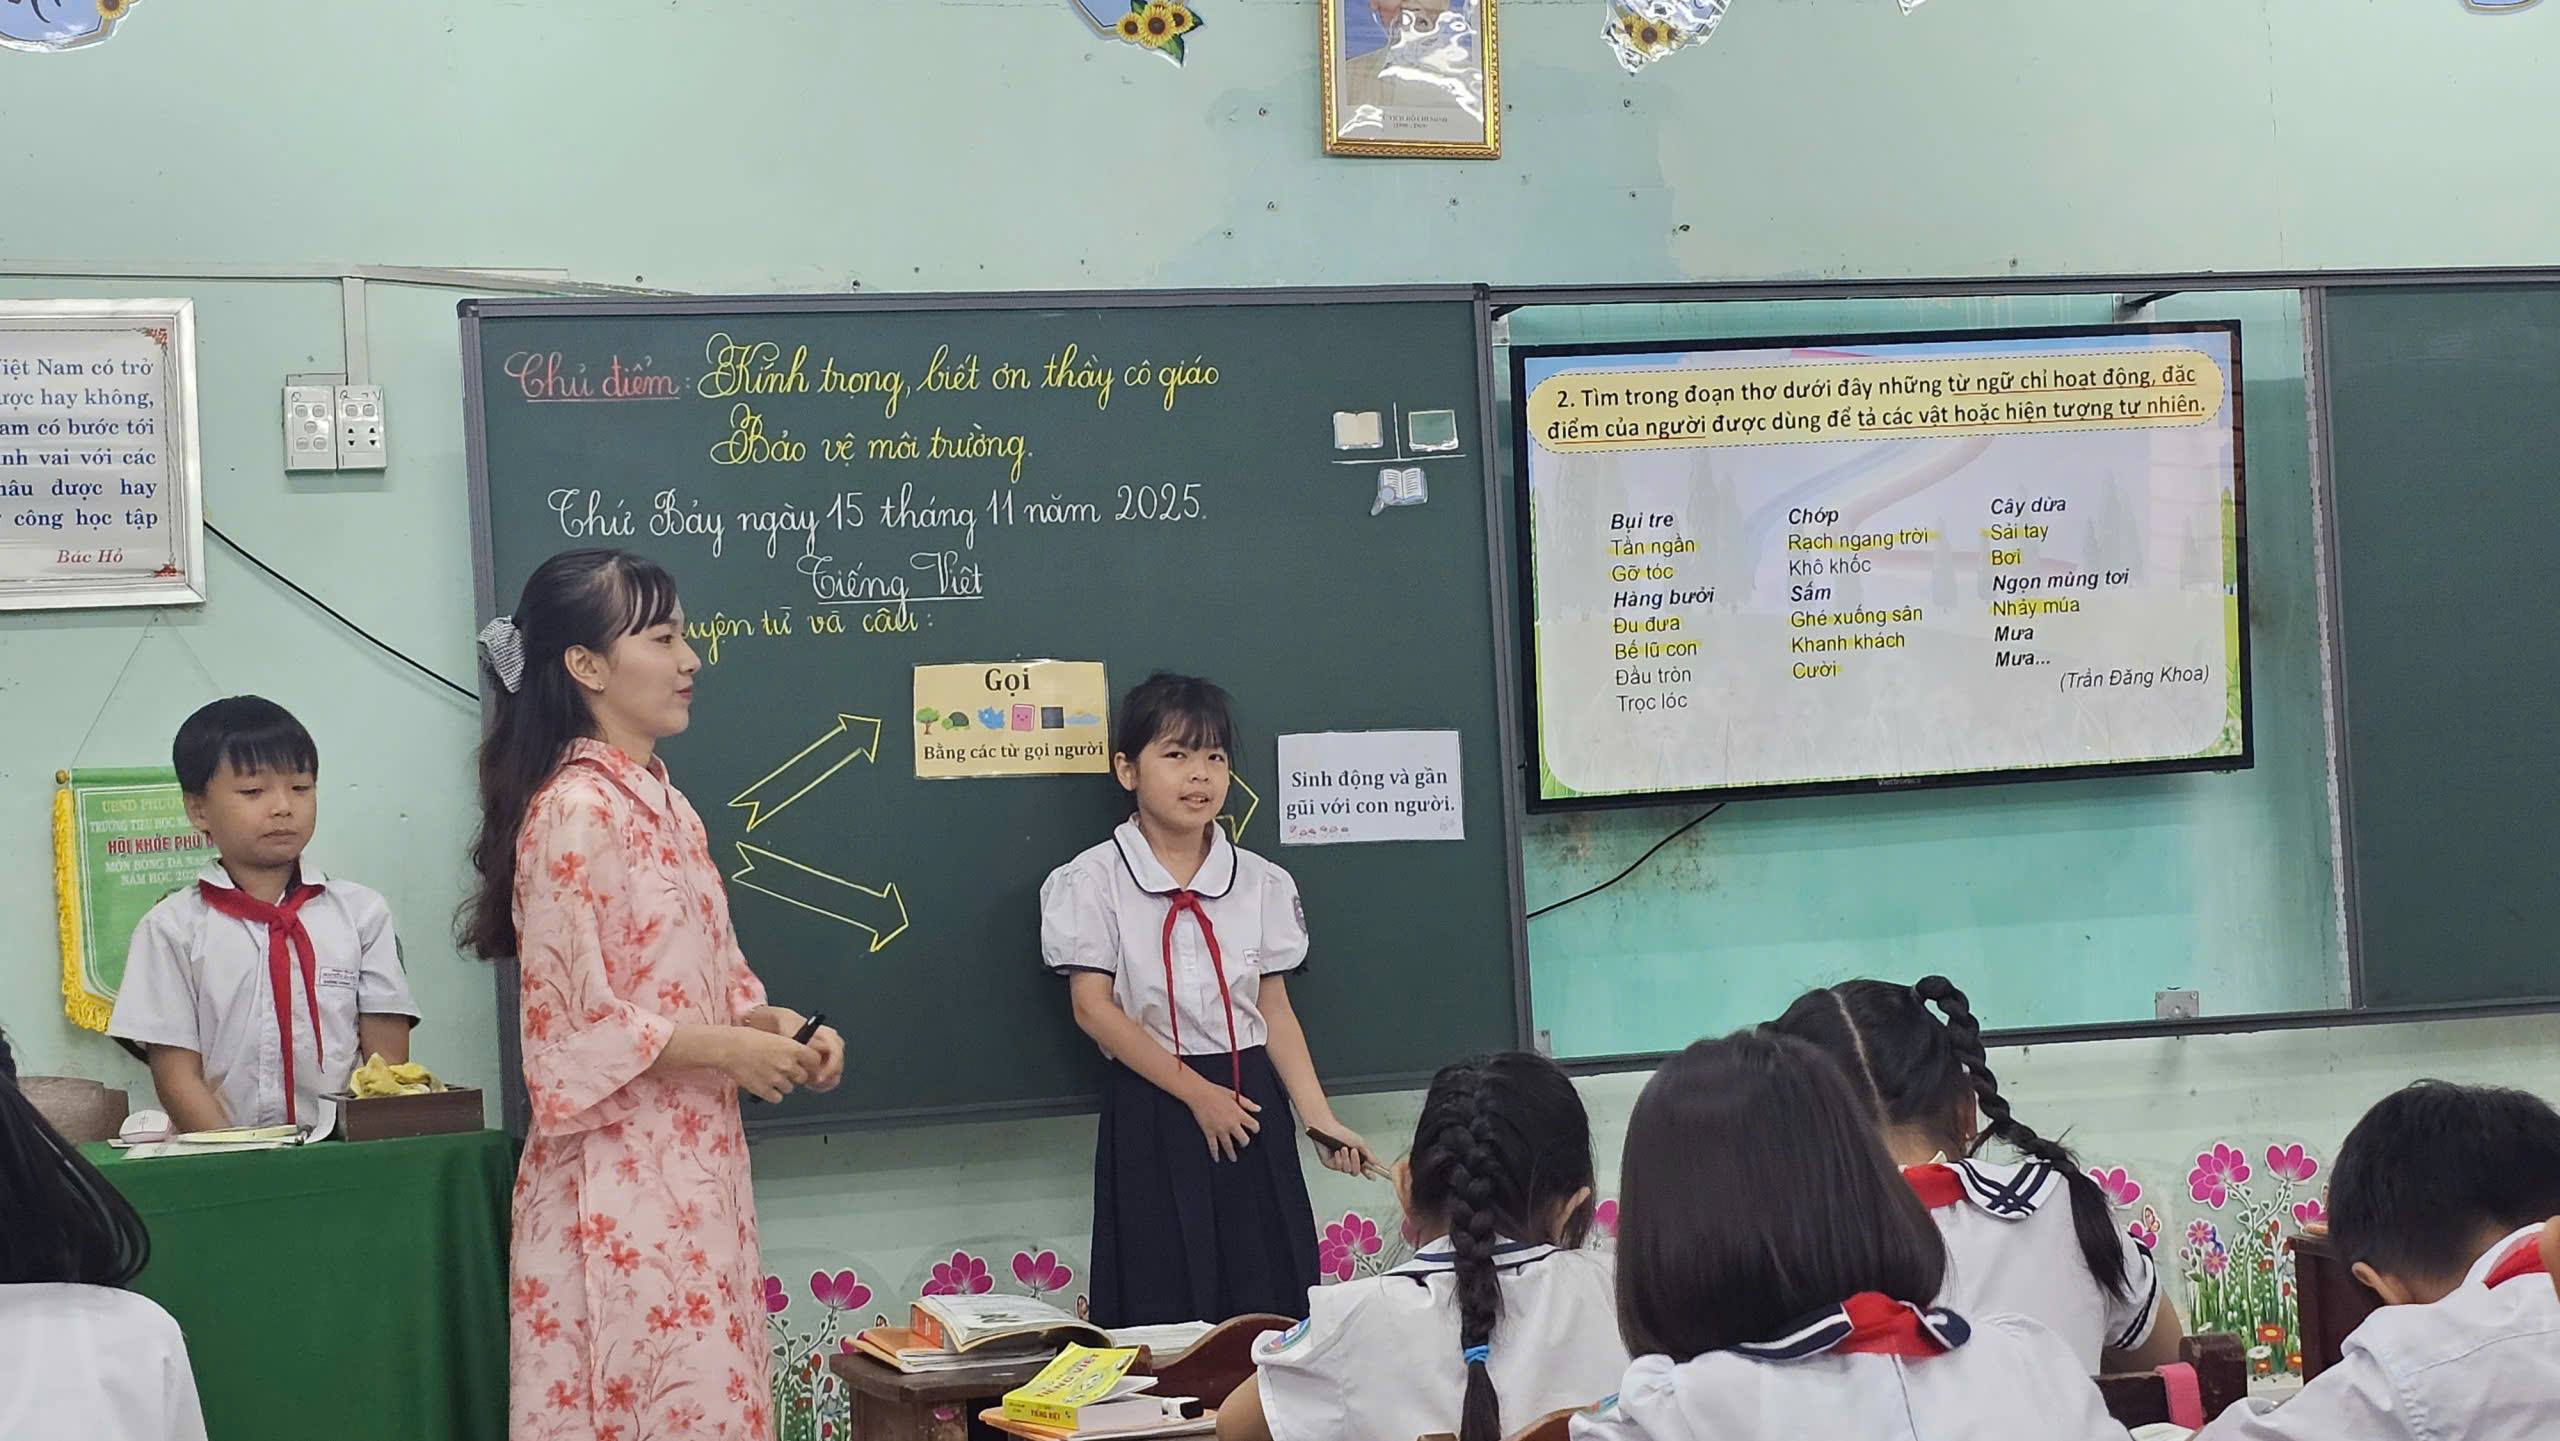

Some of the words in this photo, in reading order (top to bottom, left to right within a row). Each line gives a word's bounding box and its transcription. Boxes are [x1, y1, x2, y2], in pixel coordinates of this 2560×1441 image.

[0, 359, 30, 380] iệt
[36, 359, 83, 376] Nam
[91, 358, 114, 376] có
[121, 356, 153, 376] trở
[504, 351, 593, 397] Chủ
[698, 333, 809, 398] Kính
[917, 344, 980, 391] biết
[992, 362, 1031, 389] ơn
[1040, 343, 1114, 411] thầy
[1124, 360, 1151, 386] cô
[1158, 354, 1220, 411] giáo
[40, 388, 78, 410] hay
[84, 387, 154, 410] không,
[1557, 390, 1575, 408] 2.
[1581, 388, 1619, 407] Tìm
[1625, 388, 1679, 408] trong
[1684, 384, 1735, 408] đoạn
[1741, 381, 1775, 400] thơ
[1783, 378, 1832, 399] dưới
[1838, 377, 1873, 399] đây
[1879, 374, 1942, 397] những
[1948, 372, 1970, 393] từ
[1977, 371, 2013, 394] ngữ
[2020, 368, 2047, 389] chỉ
[0, 422, 29, 436] am
[37, 417, 60, 436] có
[68, 418, 119, 436] bước
[127, 418, 154, 435] tới
[1548, 417, 1599, 441] điểm
[1605, 416, 1640, 438] của
[1646, 414, 1706, 440] người
[1712, 413, 1766, 435] được
[1772, 409, 1821, 433] dùng
[1827, 406, 1851, 429] để
[1858, 406, 1876, 427] tả
[1883, 403, 1914, 426] các
[1919, 402, 1949, 427] vật
[1954, 400, 2001, 425] hoặc
[2006, 399, 2047, 424] hiện
[2053, 397, 2113, 421] tượng
[2119, 397, 2142, 418] tự
[2147, 395, 2206, 415] nhiên.
[710, 403, 806, 464] Bảo
[822, 432, 855, 467] vệ
[868, 432, 920, 459] môi
[926, 423, 1033, 483] trường.
[39, 447, 69, 466] vai
[80, 446, 112, 465] với
[122, 445, 156, 465] các
[120, 479, 157, 499] hay
[1788, 507, 1839, 526] Chớp
[1991, 498, 2025, 517] Cây
[2031, 496, 2066, 513] dừa
[14, 510, 64, 529] công
[76, 509, 112, 530] học
[125, 508, 158, 530] tập
[548, 489, 636, 537] Thứ
[650, 488, 725, 558] Bảy
[737, 503, 819, 559] ngày
[826, 492, 864, 531] 15
[880, 482, 977, 550] tháng
[985, 488, 1013, 525] 11
[1023, 493, 1101, 523] năm
[1610, 513, 1643, 534] Bụi
[1649, 514, 1674, 528] tre
[1788, 533, 1833, 553] Rạch
[1840, 533, 1893, 551] ngang
[1899, 528, 1929, 545] trời
[1990, 523, 2018, 540] Sải
[2024, 524, 2049, 543] tay
[57, 549, 91, 564] Bác
[1789, 558, 1824, 576] Khô
[1829, 553, 1872, 574] khốc
[1991, 549, 2021, 566] Bơi
[1612, 565, 1641, 583] Gỡ
[1646, 563, 1674, 580] tóc
[1993, 574, 2041, 594] Ngọn
[2105, 568, 2129, 585] tơi
[796, 553, 910, 625] Tiếng
[1613, 591, 1663, 610] Hàng
[1669, 586, 1715, 606] bưởi
[1791, 581, 1831, 602] Sấm
[1791, 610, 1827, 628] Ghé
[1832, 604, 1887, 627] xuống
[1892, 606, 1923, 621] sân
[1993, 599, 2037, 619] Nhảy
[2043, 596, 2080, 613] múa
[1613, 617, 1638, 634] Đu
[1645, 615, 1681, 633] đưa
[1994, 626, 2034, 642] Mưa
[684, 611, 755, 665] uyện
[1791, 636, 1847, 654] Khanh
[1854, 632, 1905, 650] khách
[1615, 640, 1639, 660] Bế
[1645, 642, 1660, 659] lũ
[1666, 643, 1697, 657] con
[1994, 650, 2051, 668] Mưa...
[984, 667, 1031, 697] Gọi
[1616, 667, 1651, 686] Đầu
[1658, 666, 1692, 684] tròn
[1792, 662, 1837, 680] Cười
[2060, 667, 2104, 693] (Trần
[2109, 669, 2154, 688] Đăng
[2160, 664, 2209, 684] Khoa)
[1617, 695, 1656, 714] Trọc
[1662, 692, 1688, 710] lóc
[924, 742, 966, 763] Bằng
[970, 744, 997, 759] các
[1001, 744, 1020, 758] từ
[1024, 743, 1050, 761] gọi
[1054, 741, 1104, 760] người
[1291, 770, 1332, 788] Sinh
[1338, 769, 1385, 790] động
[1390, 769, 1410, 785] và
[1415, 766, 1448, 789] gần
[1286, 799, 1315, 820] gũi
[1320, 797, 1351, 815] với
[1356, 801, 1388, 814] con
[1394, 795, 1455, 816] người.
